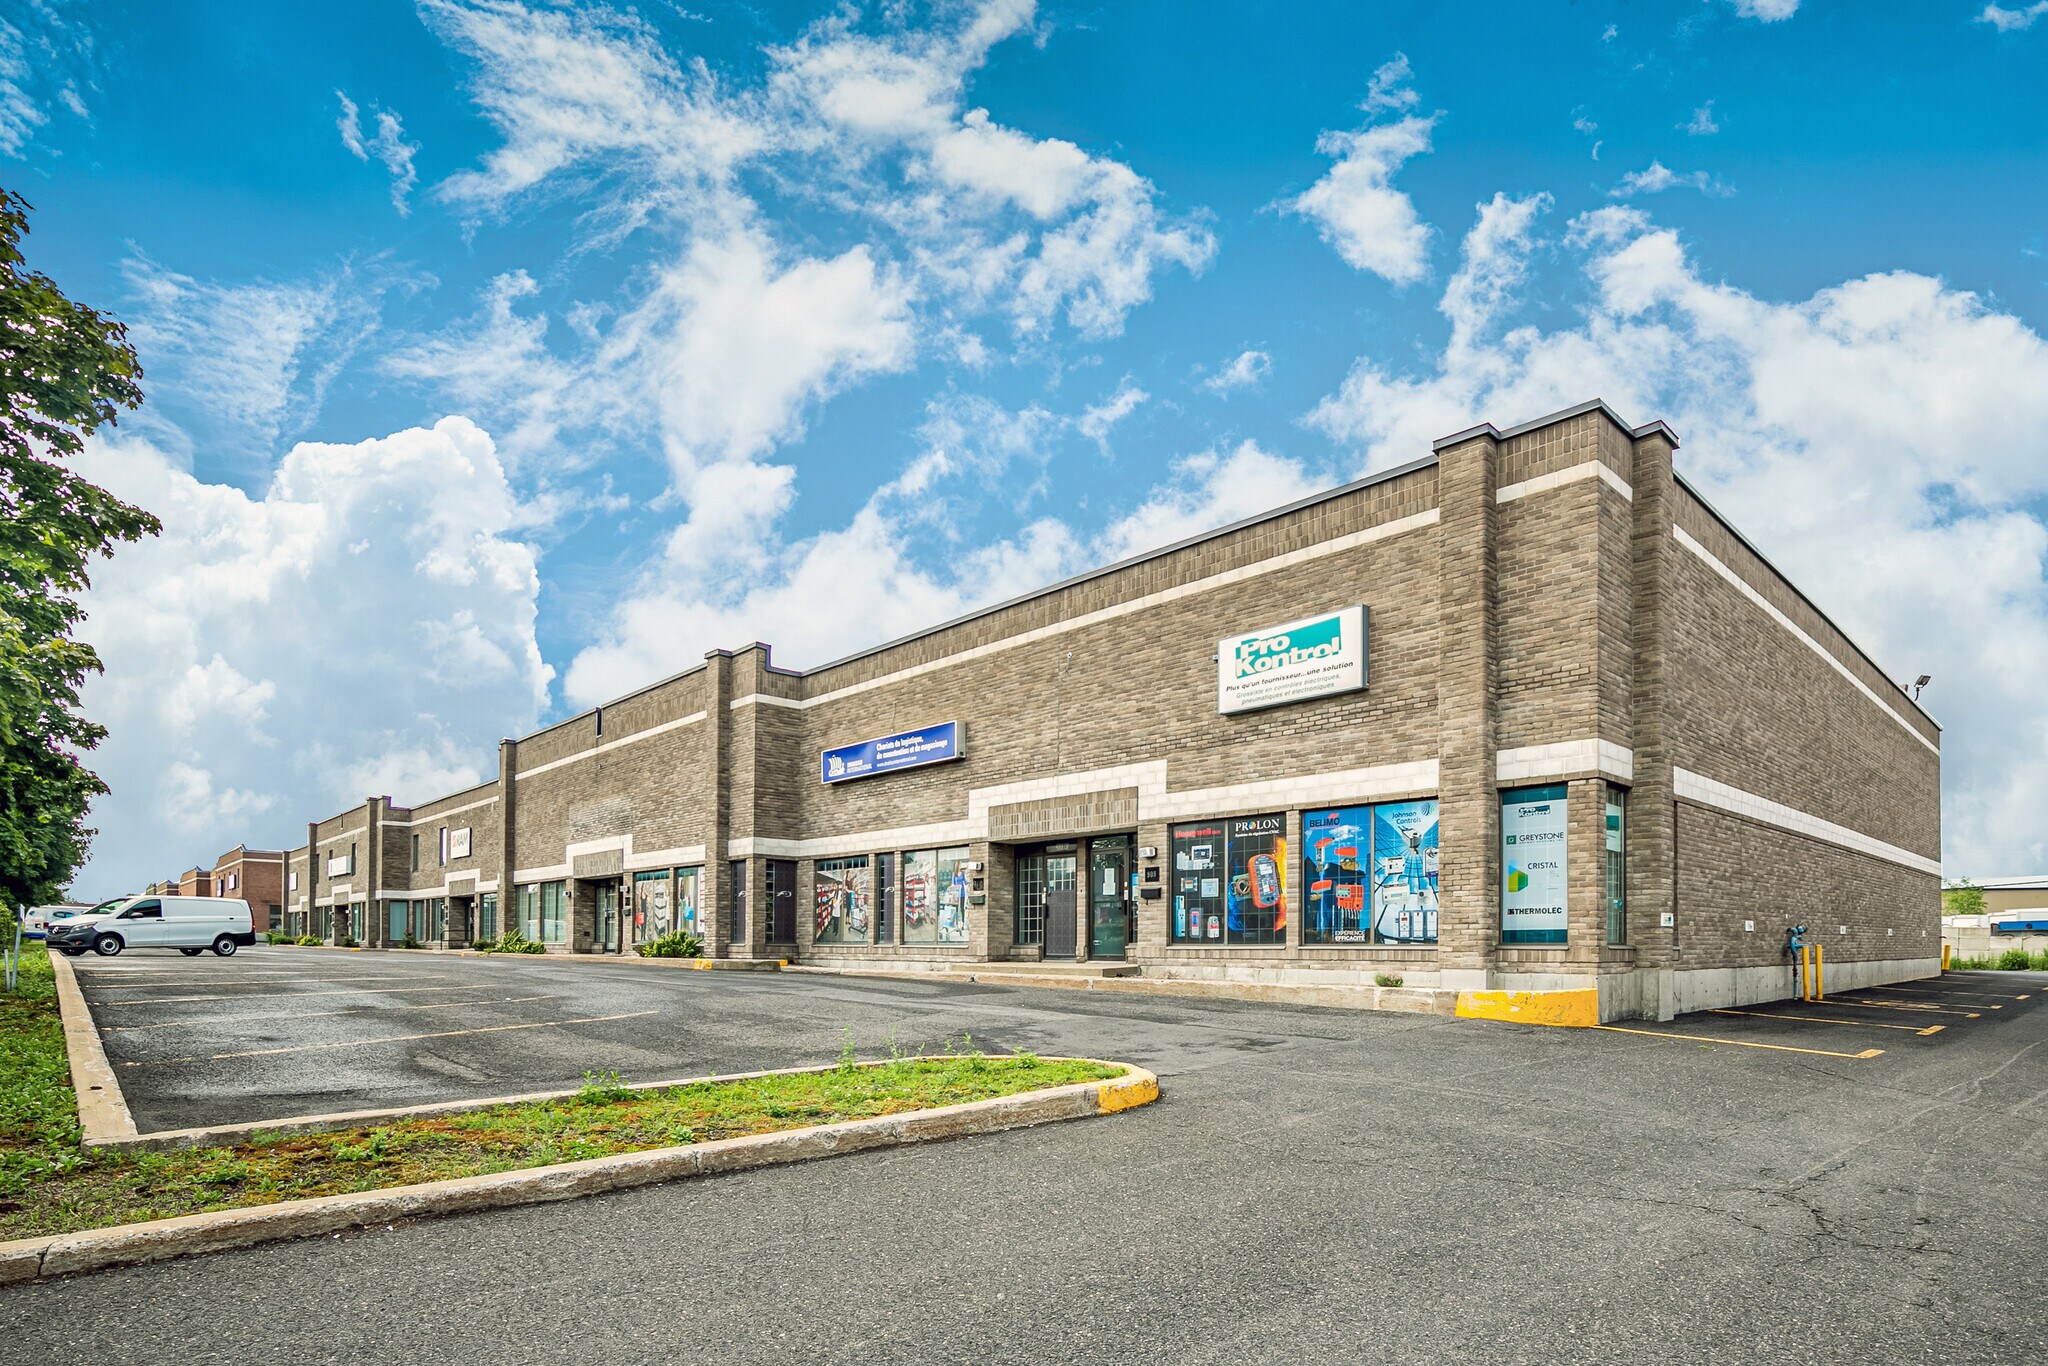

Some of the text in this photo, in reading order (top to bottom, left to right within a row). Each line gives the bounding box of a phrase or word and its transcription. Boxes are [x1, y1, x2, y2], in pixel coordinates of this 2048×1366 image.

[1240, 635, 1290, 659] Pro
[1235, 637, 1341, 678] Kontrol
[1226, 684, 1240, 692] Plus
[1241, 680, 1260, 689] qu'un
[1323, 661, 1354, 673] solution
[1236, 688, 1264, 699] Grossiste
[1274, 681, 1303, 691] contrôles
[1242, 692, 1283, 705] pneumatiques
[1392, 811, 1417, 820] Johnson
[1396, 816, 1421, 825] Controls
[1235, 819, 1280, 832] PROLON
[1309, 818, 1340, 828] BELIMO
[1175, 828, 1212, 839] Honeywell
[1519, 832, 1564, 842] GREYSTONE
[1527, 862, 1558, 870] CRISTAL
[1514, 907, 1562, 915] THERMOLEC
